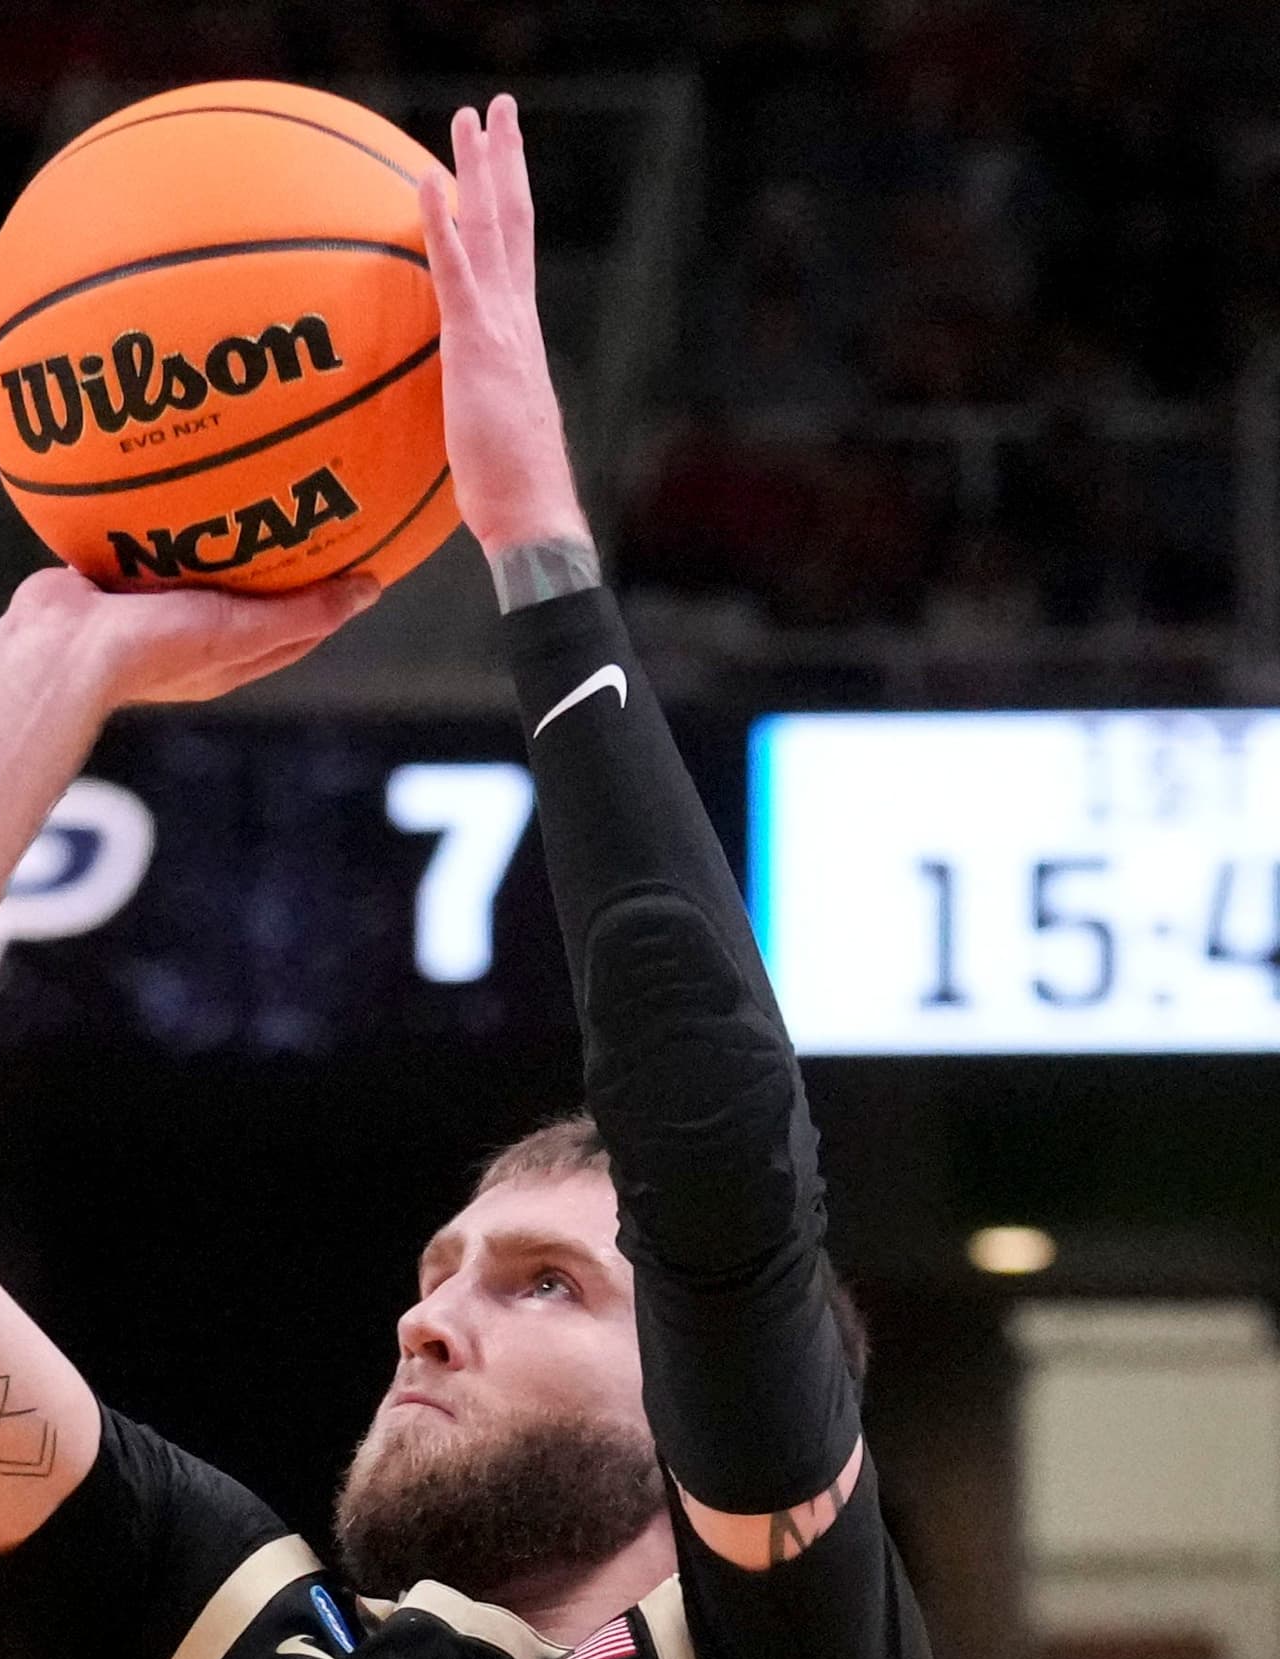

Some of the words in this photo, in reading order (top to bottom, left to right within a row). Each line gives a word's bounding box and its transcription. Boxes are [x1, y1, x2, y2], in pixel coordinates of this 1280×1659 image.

[0, 312, 343, 455] Wilson
[119, 428, 166, 454] EVO
[173, 413, 222, 438] NXT
[107, 465, 361, 578] NCAA
[386, 762, 535, 984] 7
